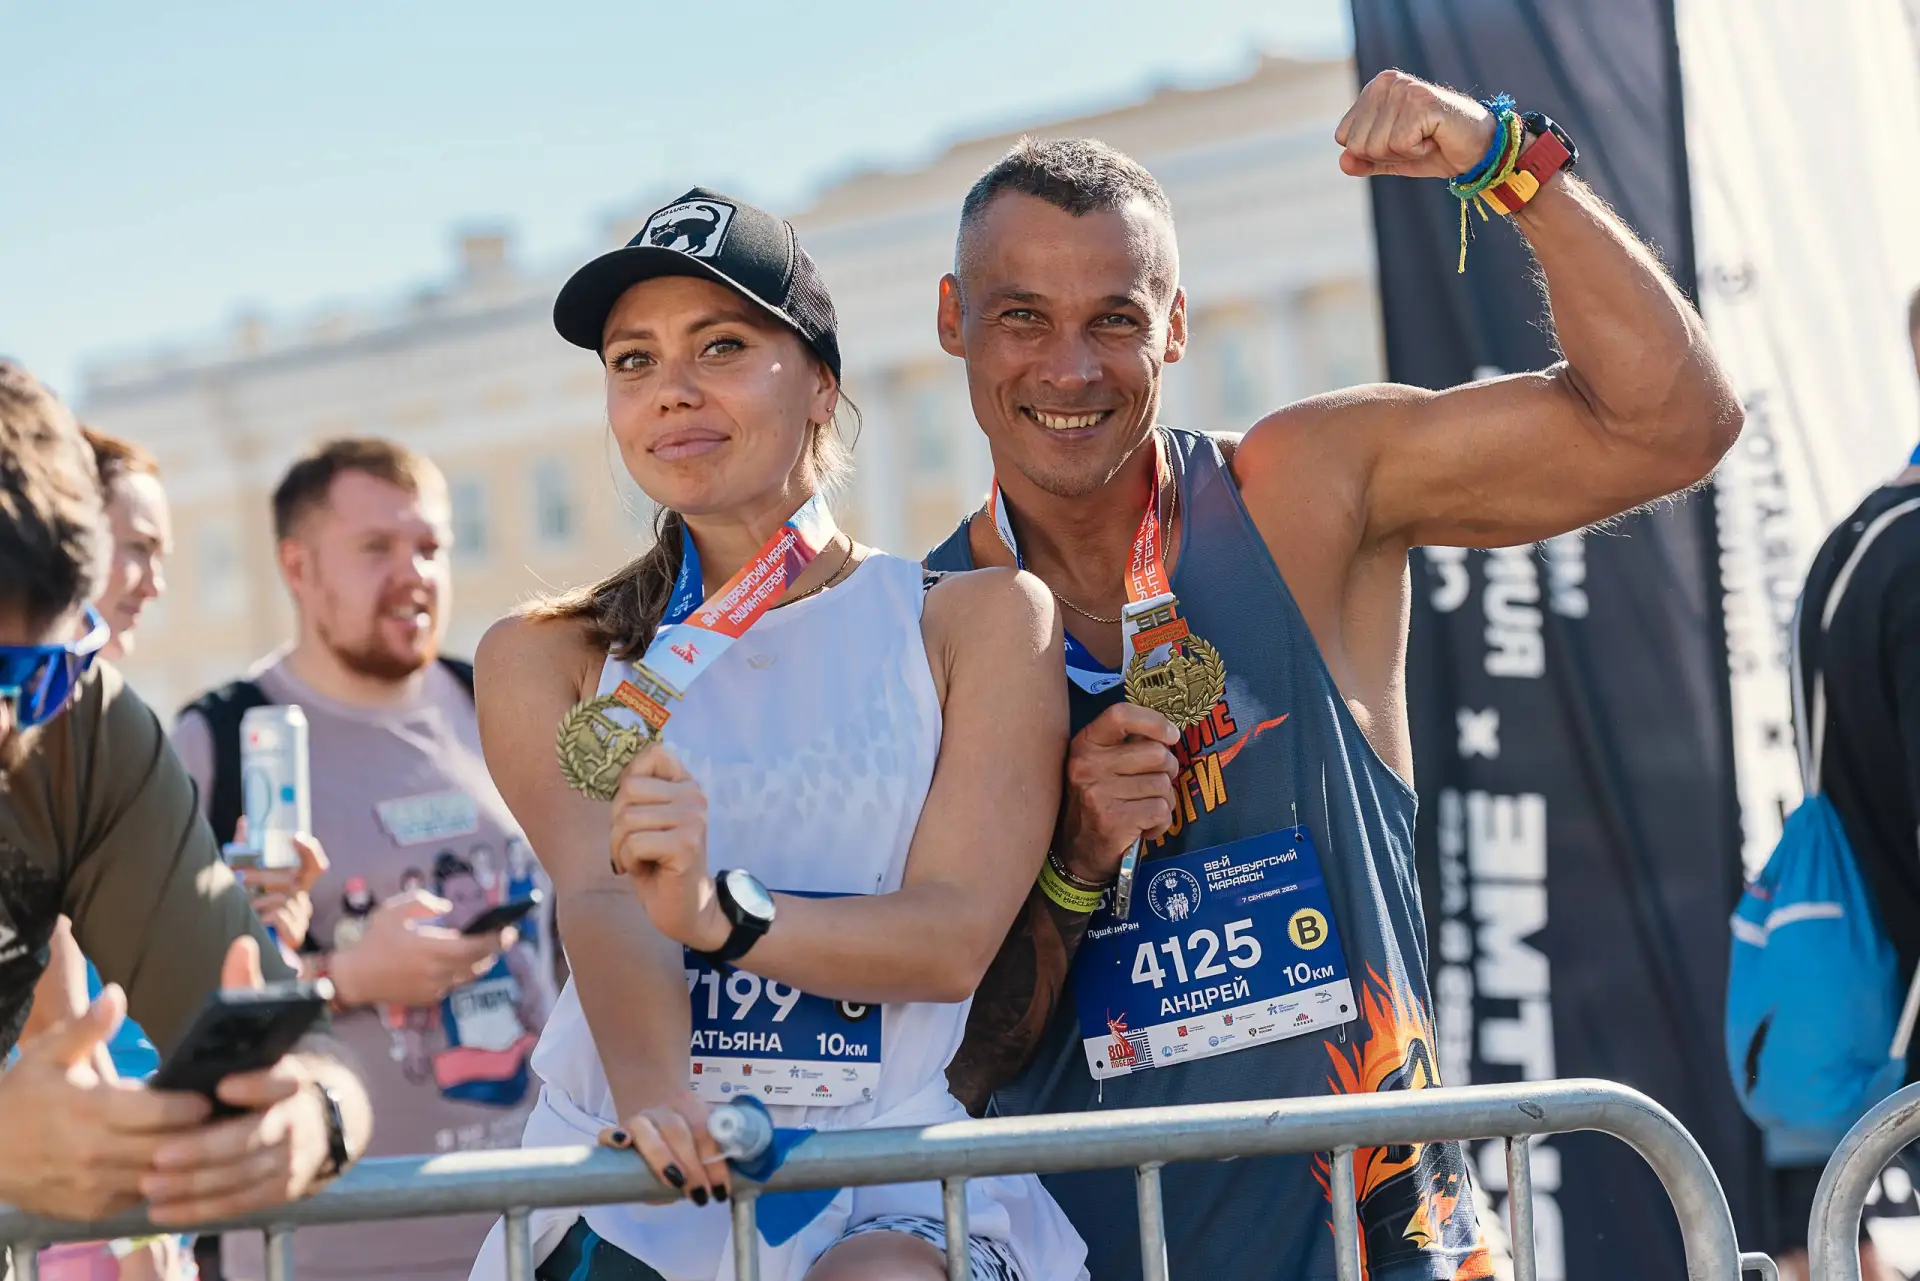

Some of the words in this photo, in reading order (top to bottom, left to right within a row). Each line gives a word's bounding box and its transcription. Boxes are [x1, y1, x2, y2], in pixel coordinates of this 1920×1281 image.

[765, 530, 798, 567] МАРАФОН
[1131, 541, 1149, 601] УРГСКИЙ
[1205, 848, 1298, 882] ПЕТЕРБУРГСКИЙ
[1208, 870, 1265, 892] МАРАФОН
[1130, 917, 1263, 990] 4125
[1159, 975, 1251, 1017] АНДРЕЙ
[690, 1030, 783, 1053] АТЬЯНА
